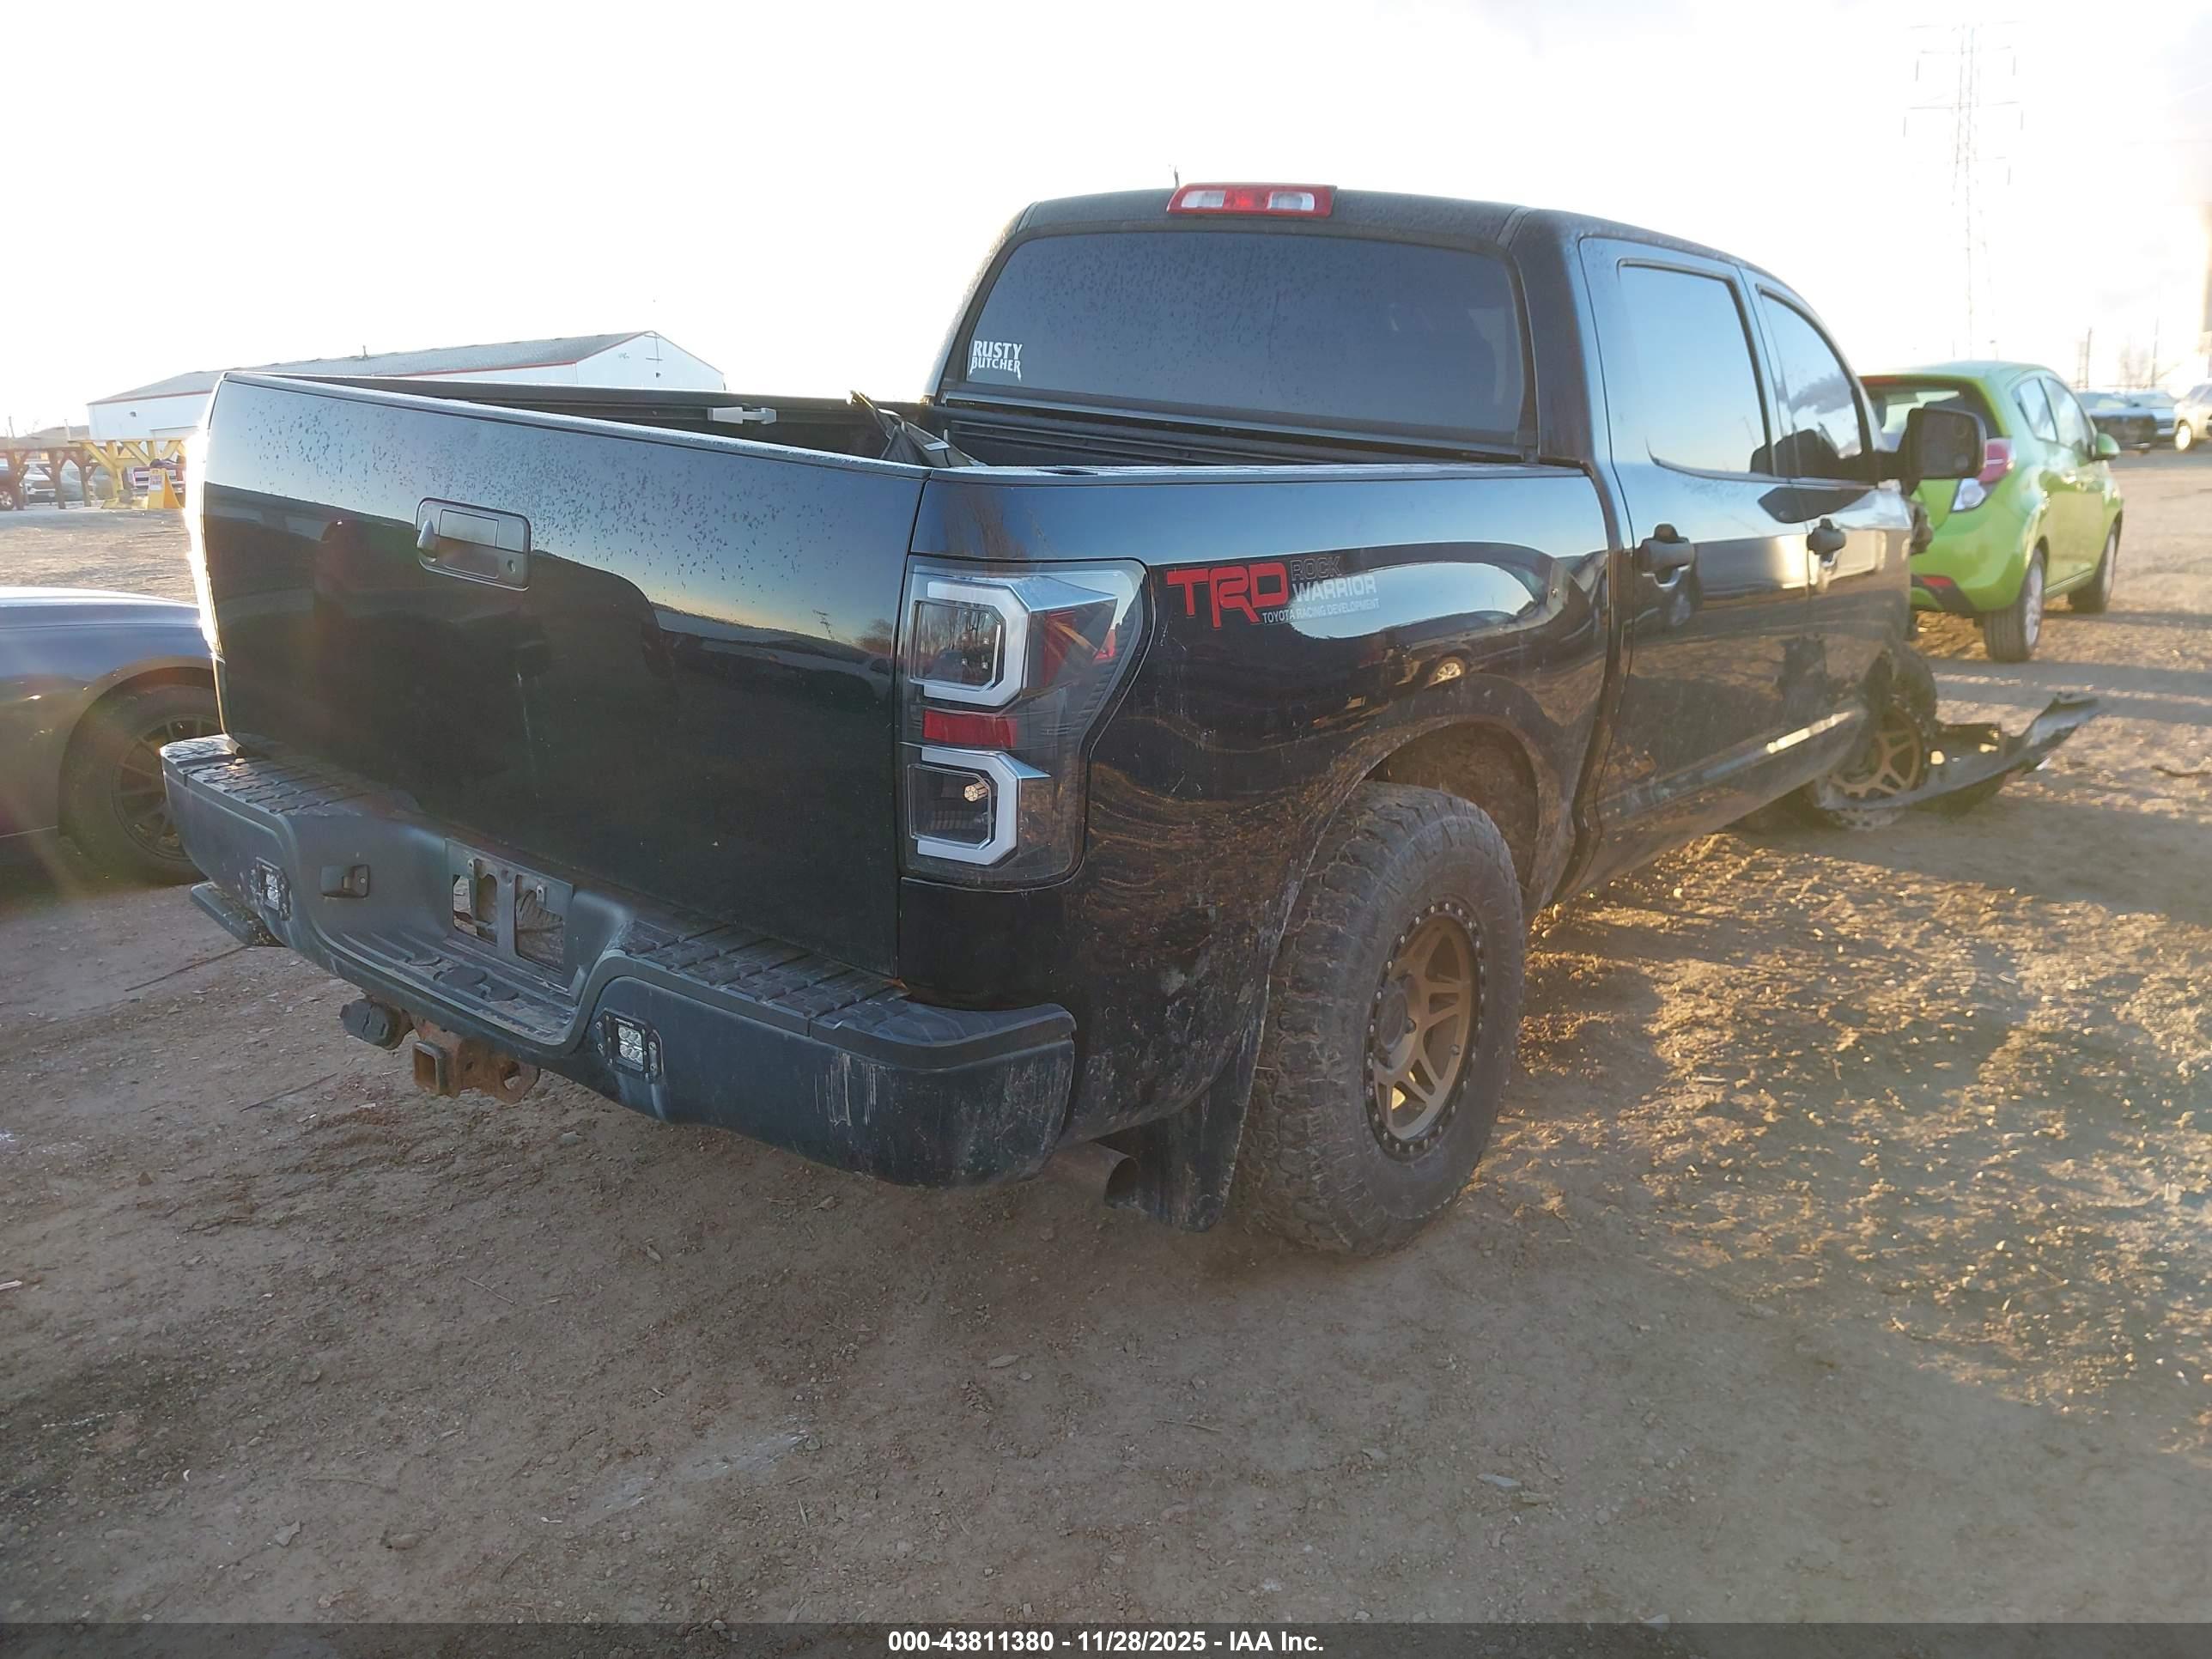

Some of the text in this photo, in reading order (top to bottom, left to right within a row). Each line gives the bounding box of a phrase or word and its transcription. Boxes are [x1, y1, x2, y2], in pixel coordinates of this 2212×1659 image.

[972, 340, 1023, 360] RUSTY
[969, 356, 1022, 382] BUTCHER
[1290, 556, 1342, 581] ROCK
[1166, 562, 1289, 630] TRD
[1292, 574, 1378, 602] WARRIOR
[1262, 598, 1380, 624] TOYOTA RACING DEVELOPMENT
